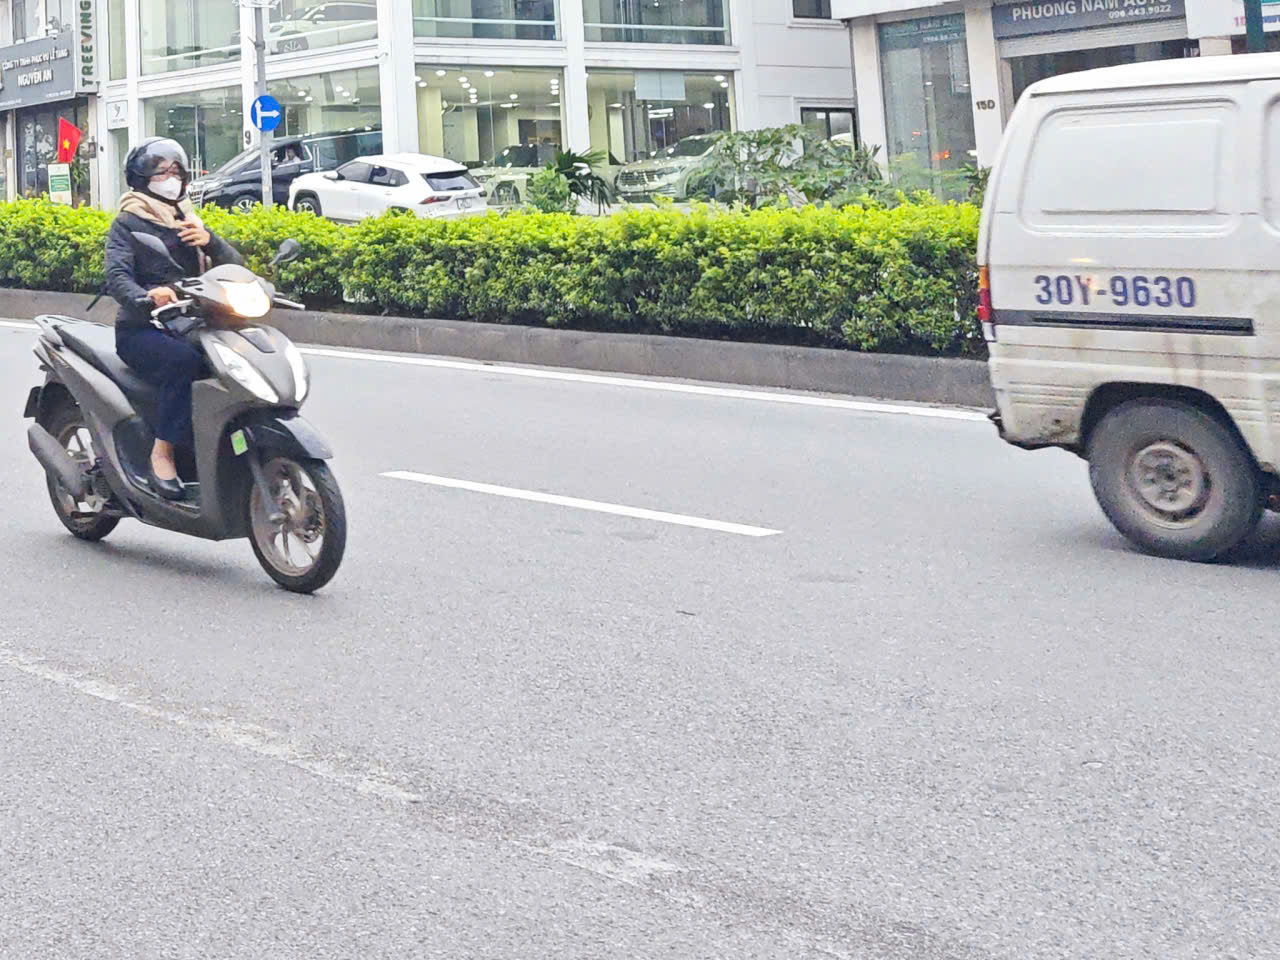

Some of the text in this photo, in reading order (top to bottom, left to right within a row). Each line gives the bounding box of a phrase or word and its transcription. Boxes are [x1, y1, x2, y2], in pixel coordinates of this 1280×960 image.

[80, 0, 94, 87] TREEVING
[976, 100, 995, 110] 15D
[244, 130, 252, 145] 9
[1033, 275, 1196, 308] 30Y-9630
